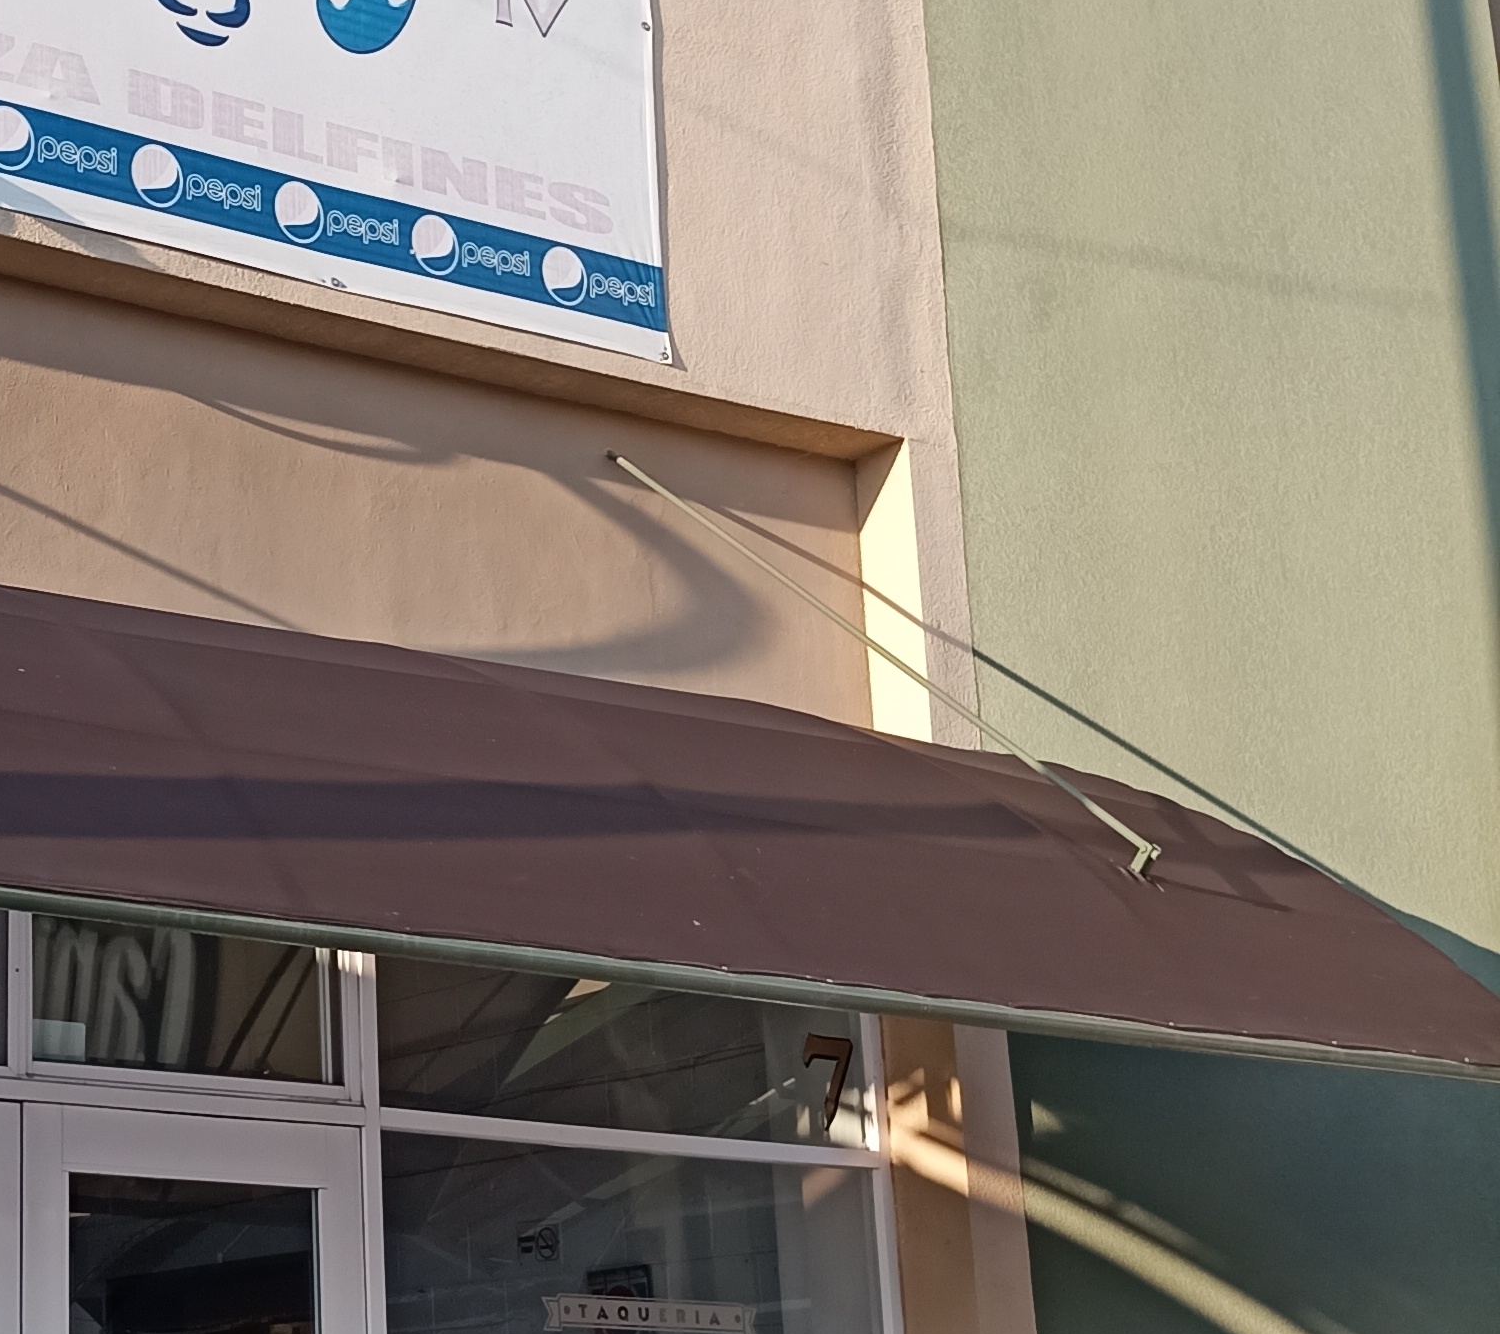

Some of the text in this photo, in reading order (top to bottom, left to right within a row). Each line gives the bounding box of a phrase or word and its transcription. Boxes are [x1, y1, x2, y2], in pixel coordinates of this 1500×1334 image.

[126, 68, 614, 236] DELFINES
[37, 135, 118, 176] pepsi
[186, 172, 261, 212] pepsi
[326, 209, 399, 246] pepsi
[461, 240, 531, 277] pepsi
[589, 271, 656, 308] pepsi
[802, 1032, 853, 1131] 7
[576, 1304, 721, 1326] TAQUERIA
